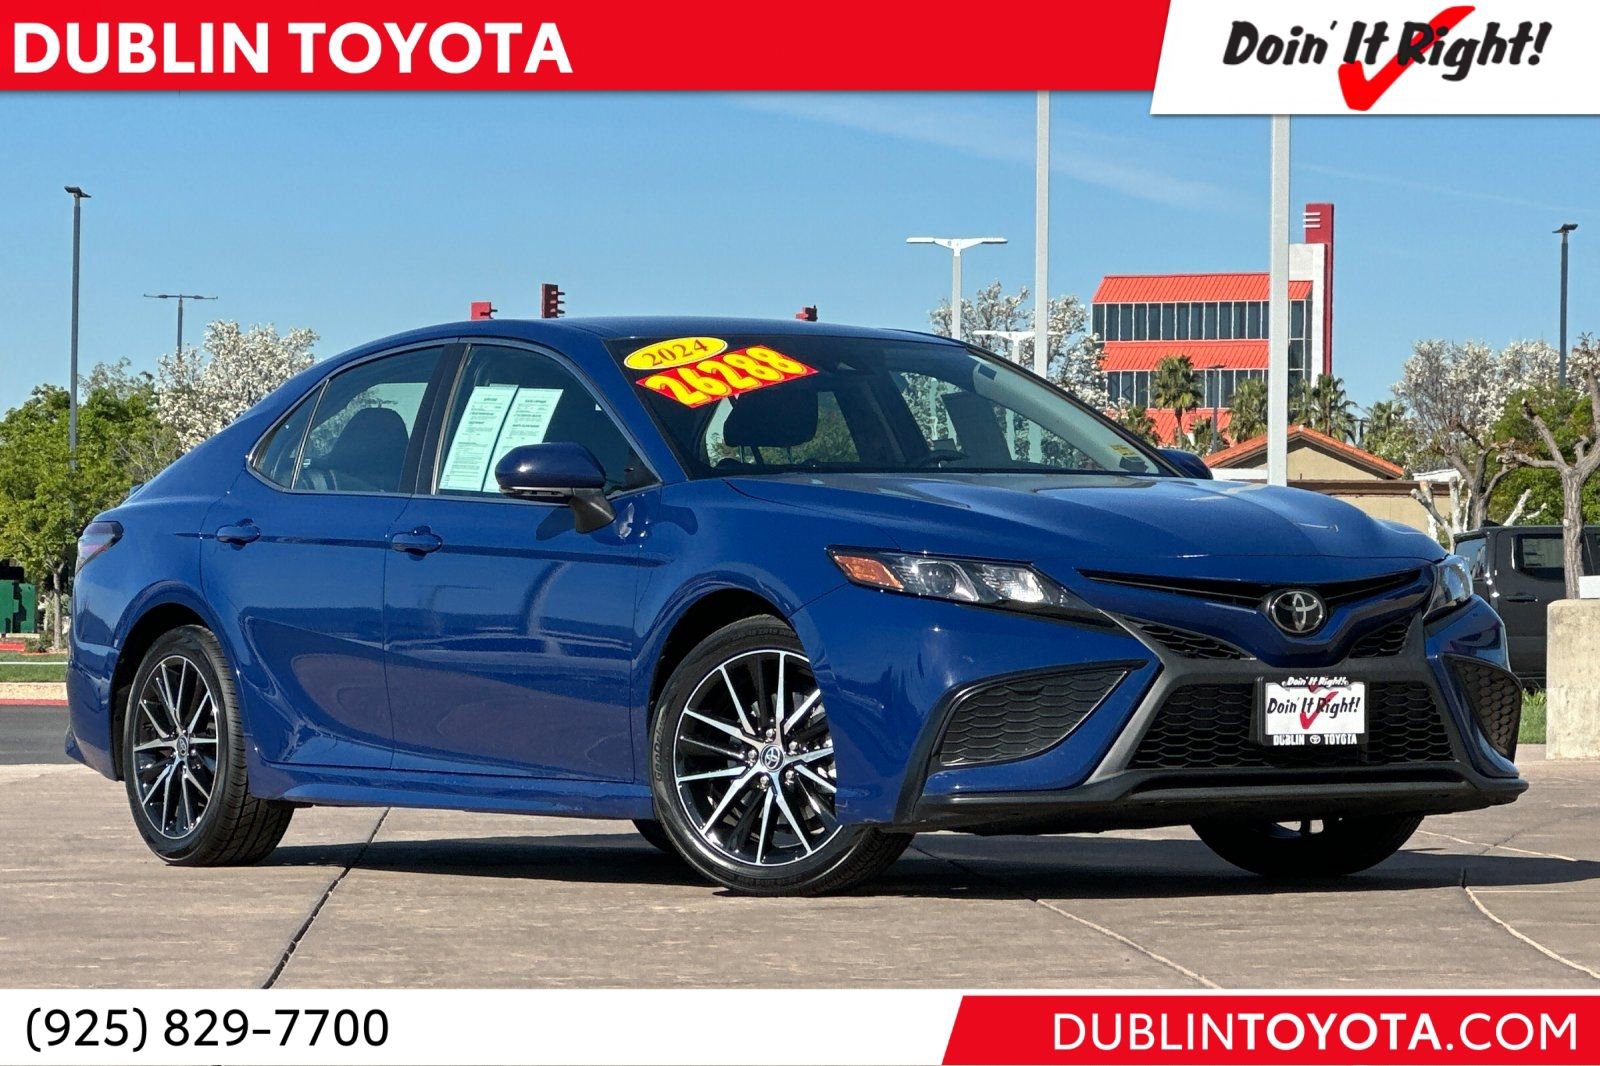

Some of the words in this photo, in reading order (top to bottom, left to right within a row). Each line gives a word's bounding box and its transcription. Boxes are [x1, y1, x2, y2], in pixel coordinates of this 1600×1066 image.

[641, 339, 709, 367] 2024
[645, 347, 808, 406] 26288
[1266, 697, 1301, 714] Doin'
[1301, 697, 1315, 714] It
[1316, 697, 1361, 719] Right!
[1273, 734, 1305, 746] DUBLIN
[1324, 734, 1358, 745] TOYOTA
